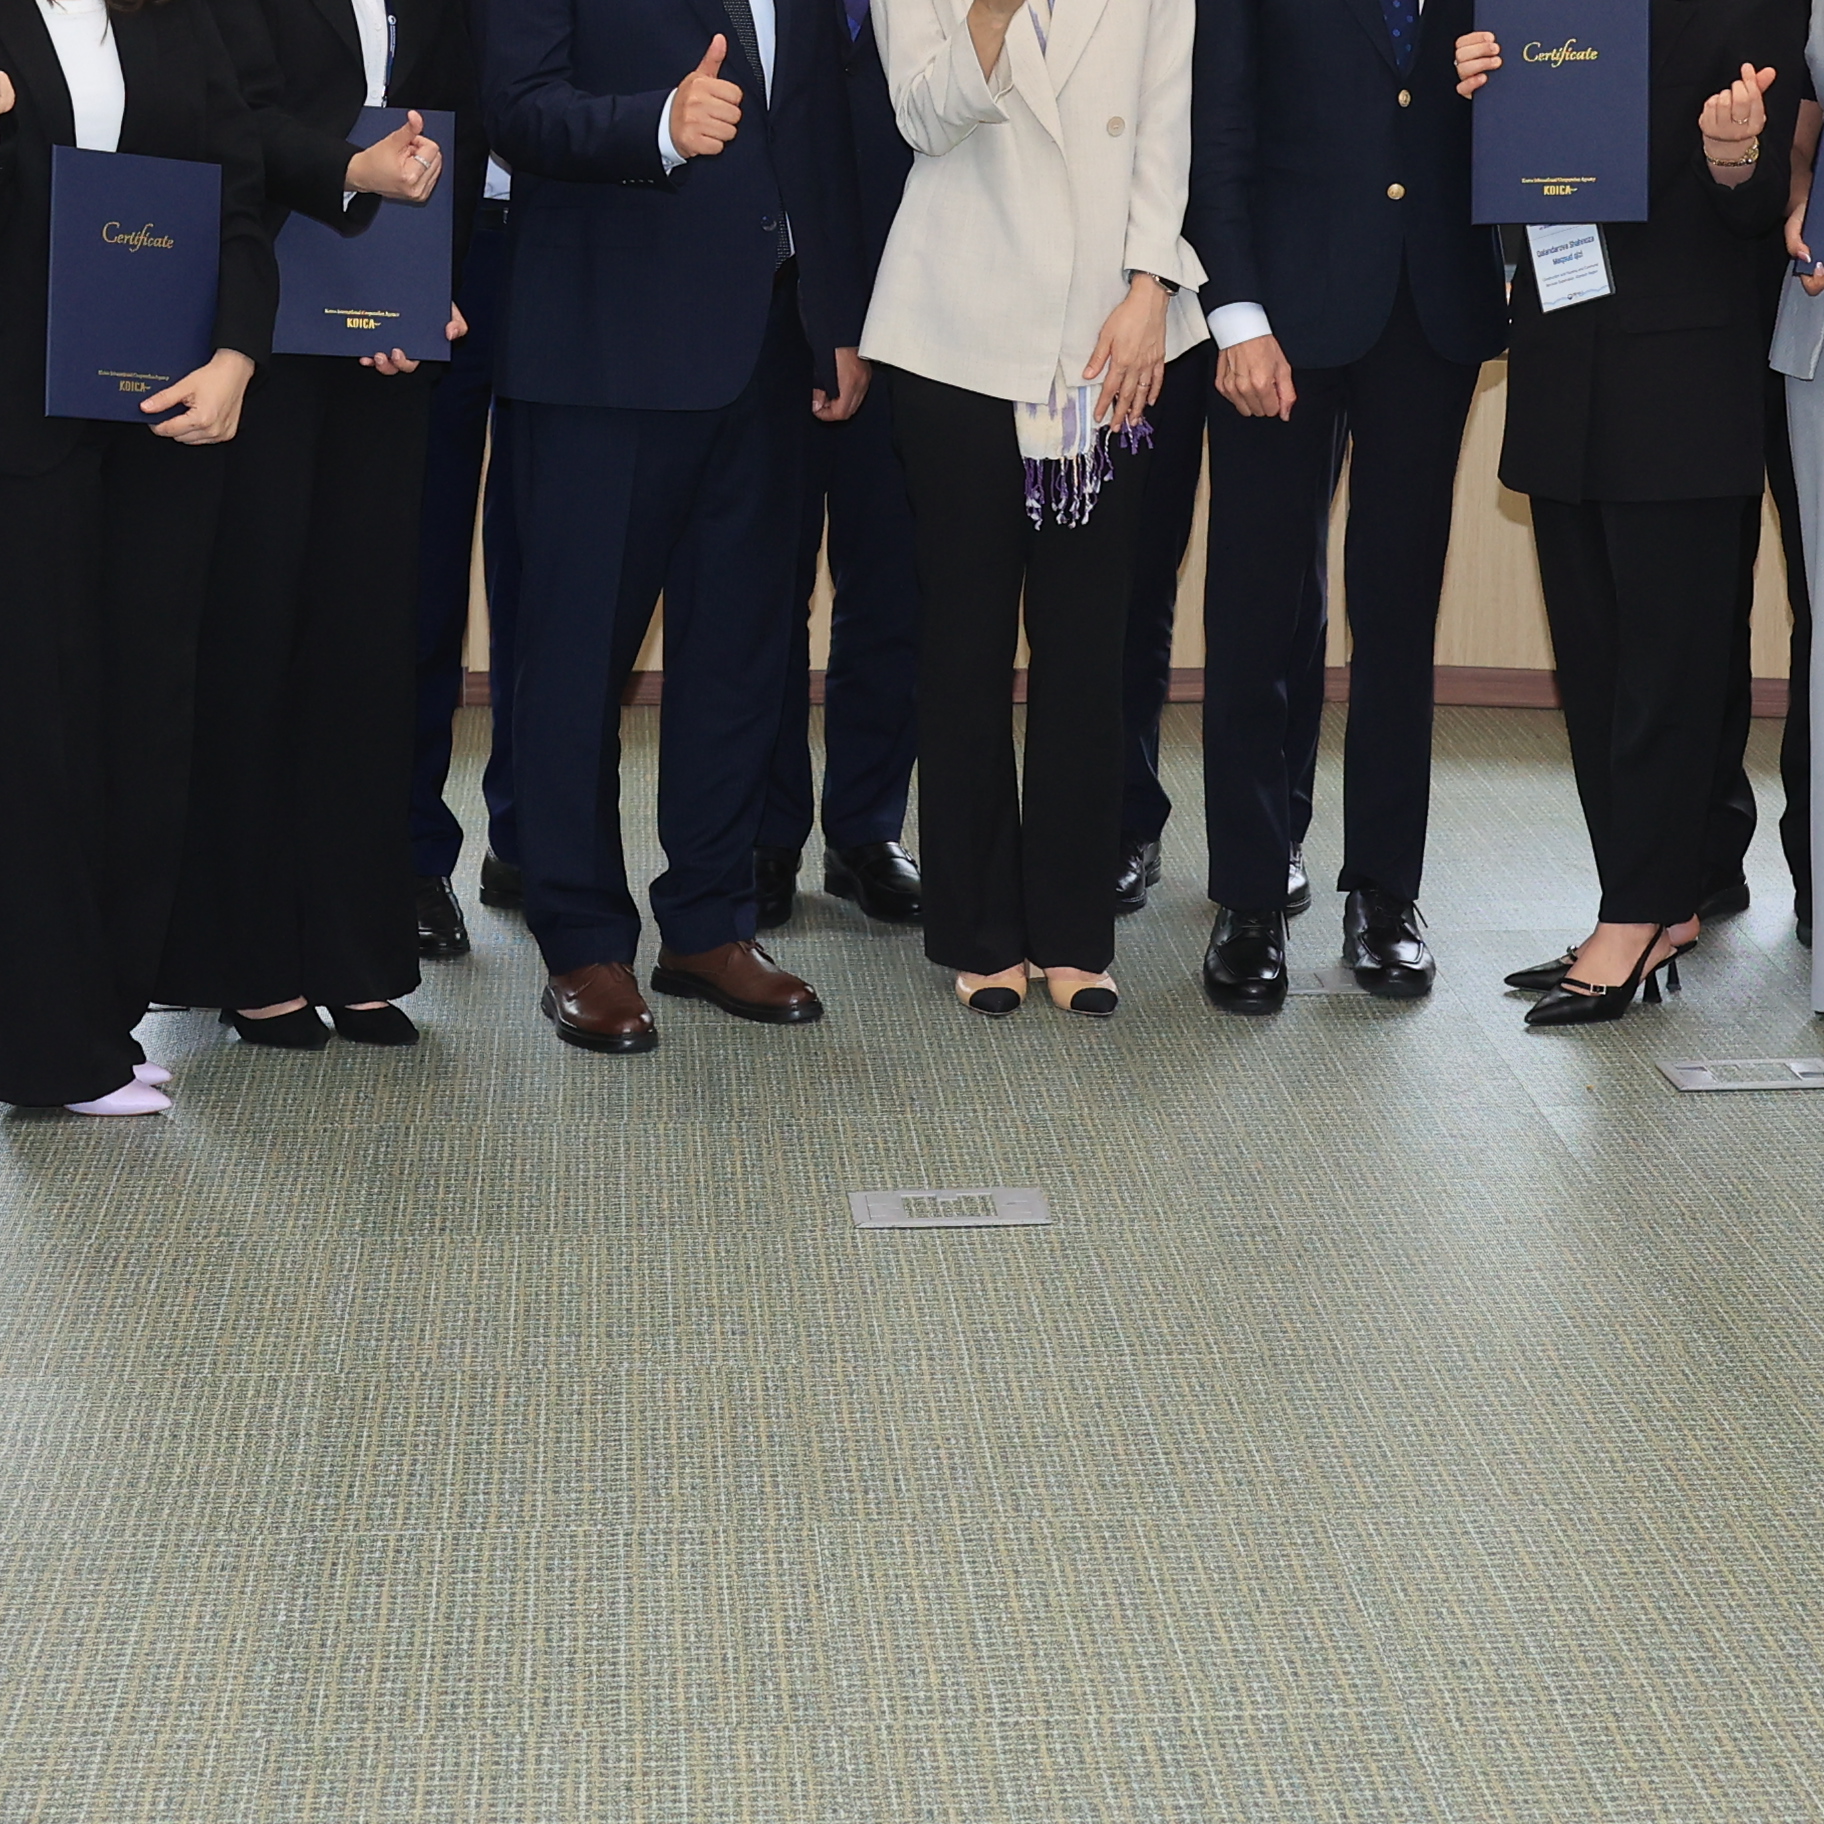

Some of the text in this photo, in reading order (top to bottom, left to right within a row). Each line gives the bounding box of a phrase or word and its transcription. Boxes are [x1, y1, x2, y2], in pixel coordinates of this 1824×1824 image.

[1523, 38, 1598, 68] Certificate
[1543, 184, 1572, 195] KOICA
[102, 221, 174, 253] Certificate
[346, 317, 376, 329] KOICA
